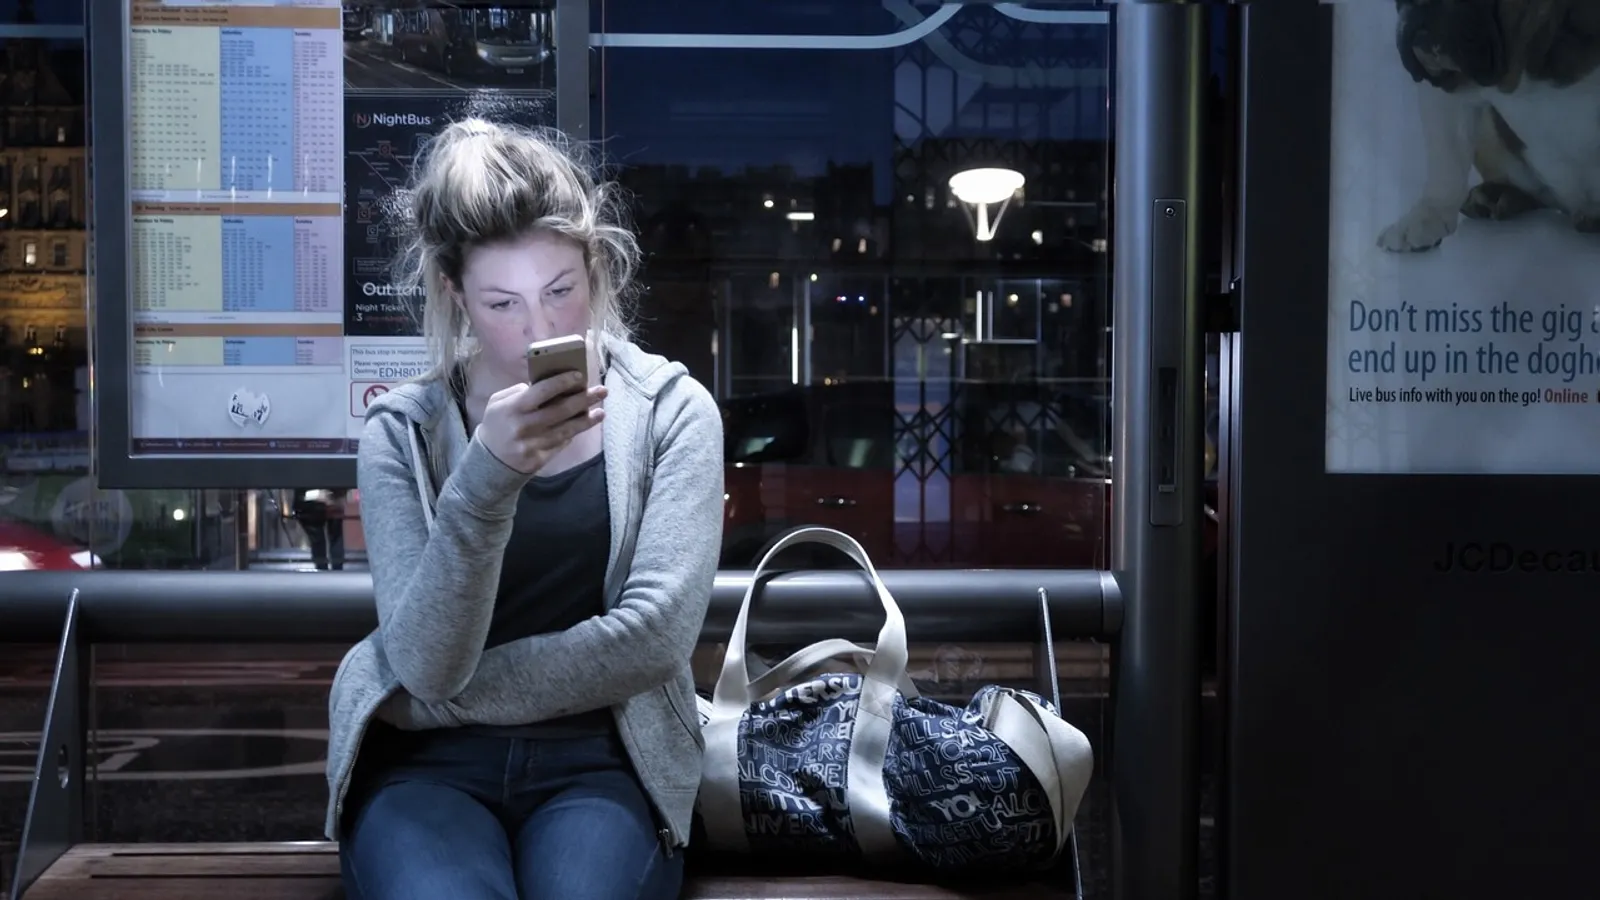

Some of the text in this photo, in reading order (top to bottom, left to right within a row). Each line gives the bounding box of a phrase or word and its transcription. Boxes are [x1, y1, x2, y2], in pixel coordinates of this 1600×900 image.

[373, 112, 432, 127] NightBus
[363, 282, 427, 297] Out toni
[355, 303, 405, 312] Night Ticket
[1350, 300, 1417, 333] Don't
[1425, 302, 1483, 333] miss
[1490, 301, 1534, 334] the
[1542, 303, 1582, 342] gig
[1348, 342, 1395, 373] end
[1405, 349, 1436, 381] up
[1445, 343, 1468, 374] in
[1476, 342, 1519, 374] the
[1350, 387, 1373, 402] Live
[1376, 387, 1397, 402] bus
[1399, 387, 1423, 402] info
[1425, 387, 1451, 403] with
[1455, 390, 1477, 406] you
[1480, 391, 1495, 403] on
[1498, 387, 1519, 403] the
[1521, 388, 1541, 407] go!
[1544, 388, 1589, 403] Online
